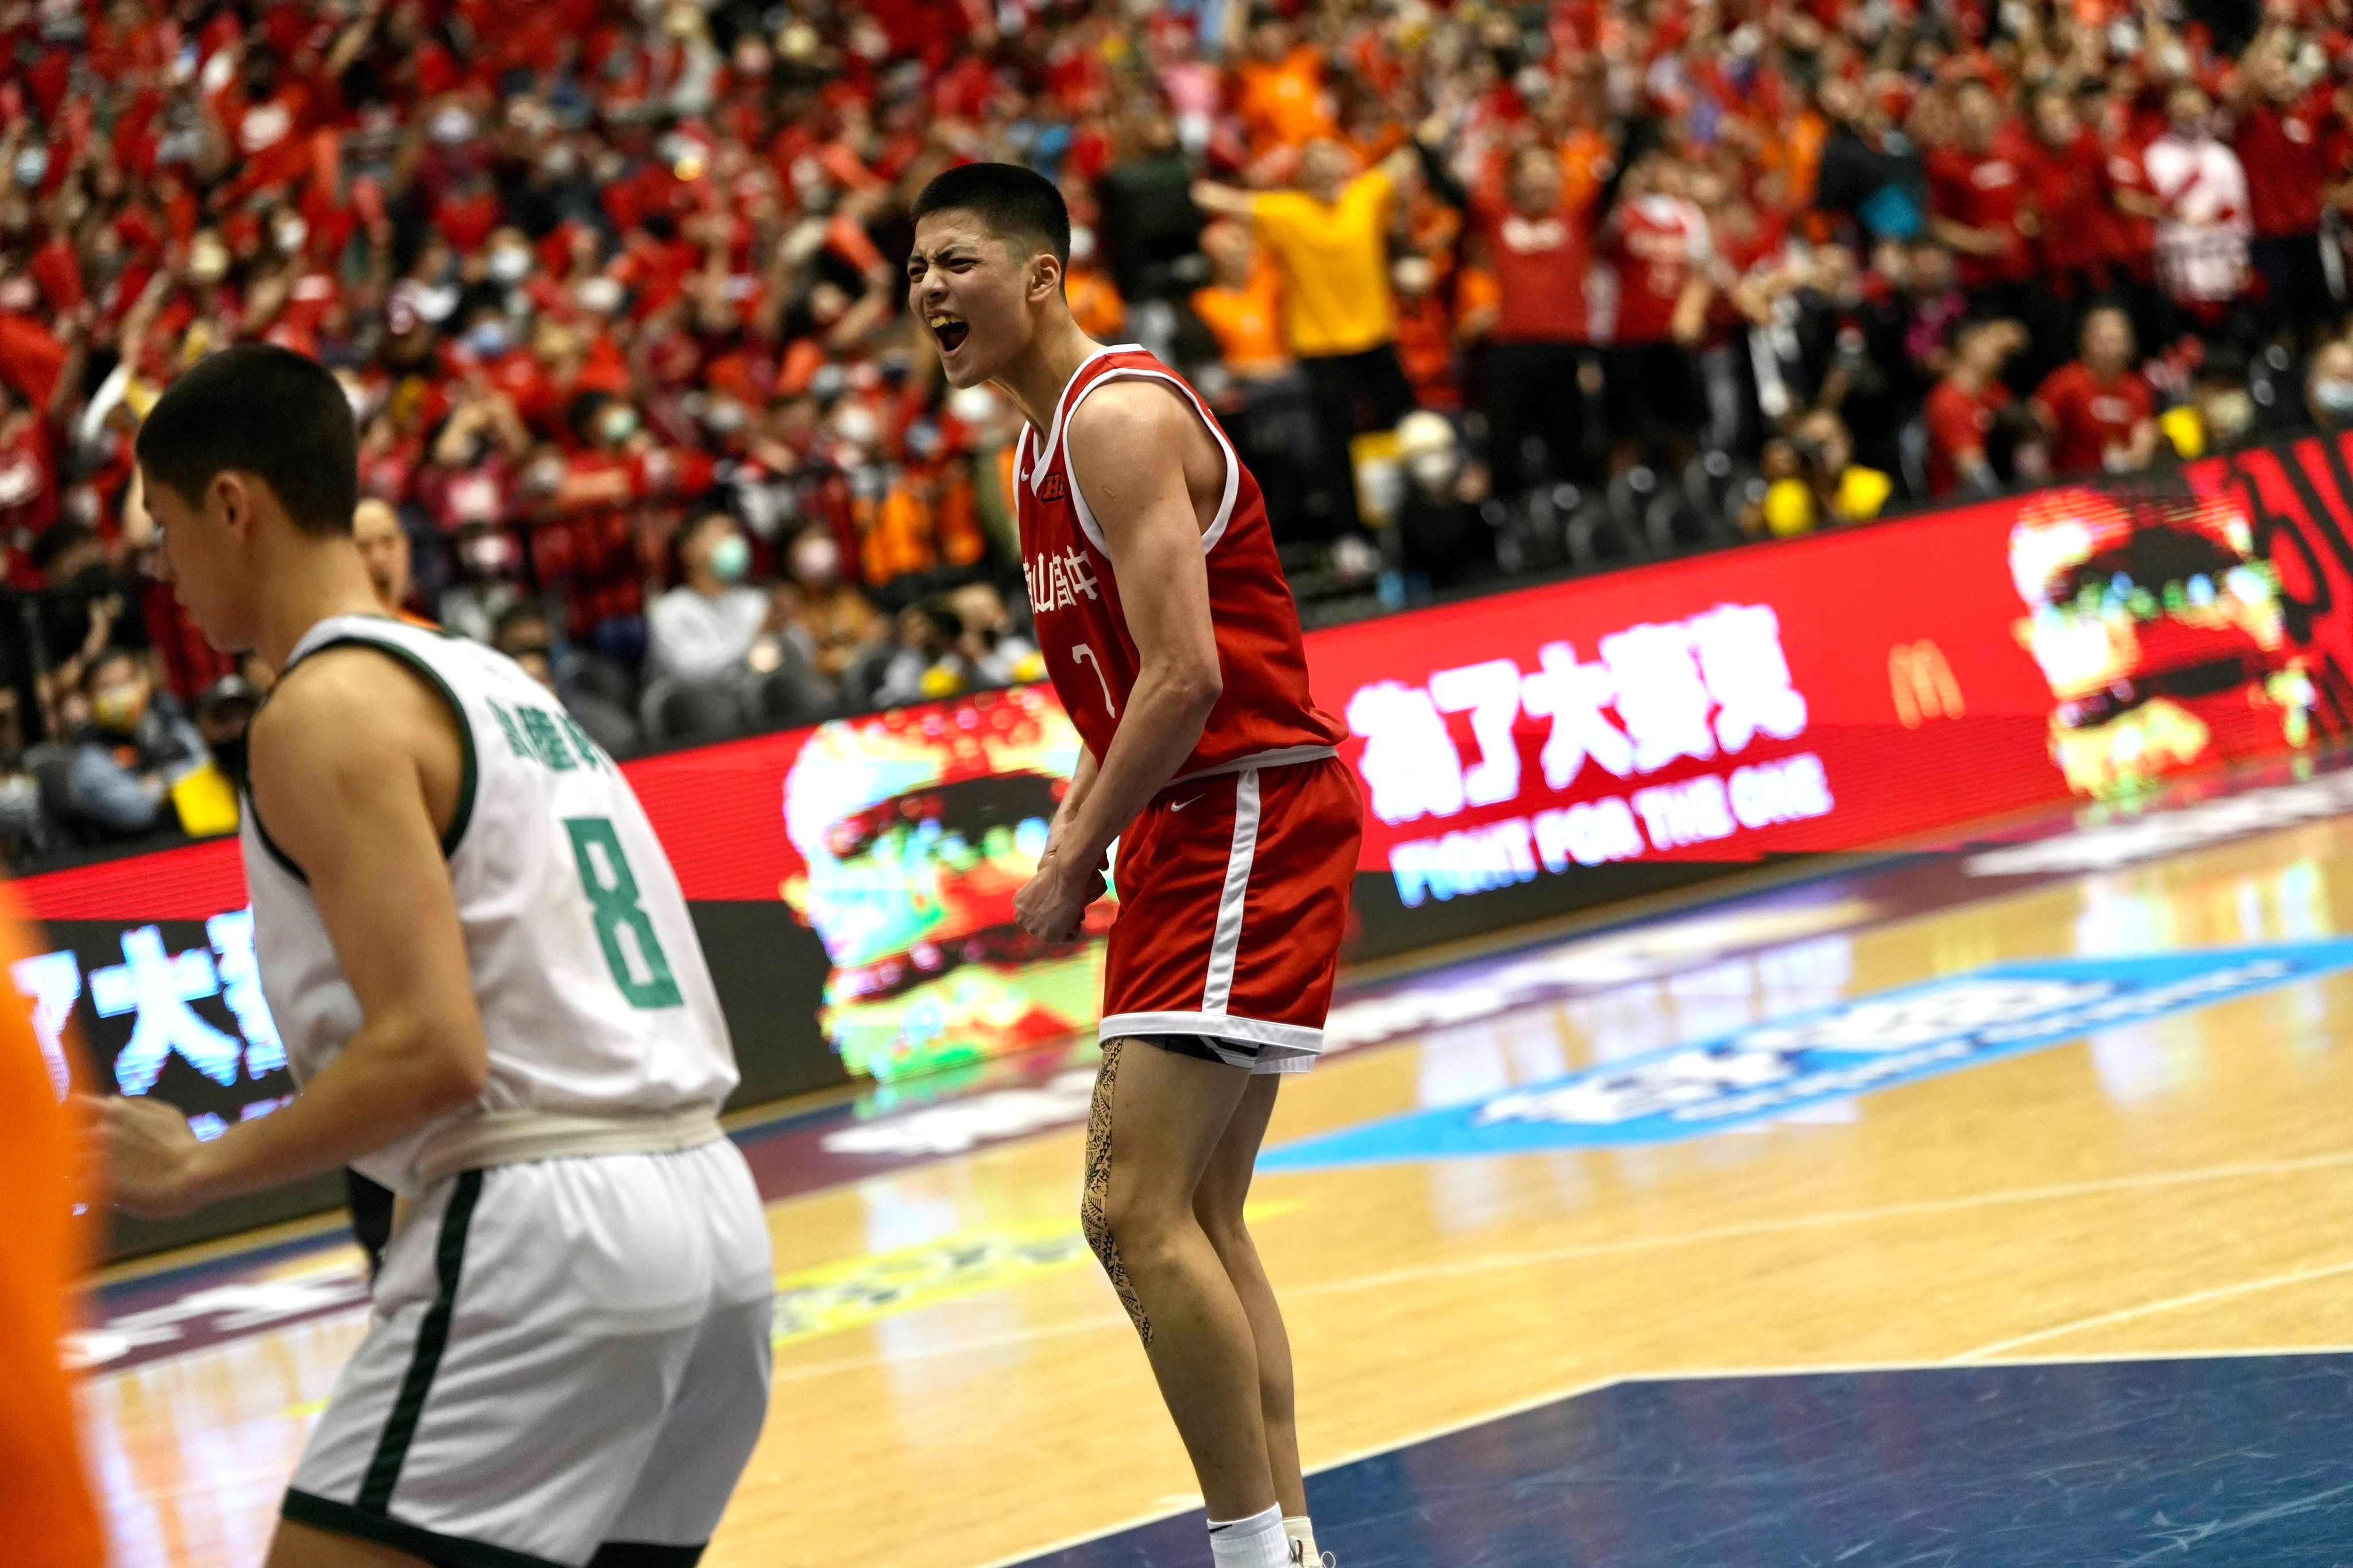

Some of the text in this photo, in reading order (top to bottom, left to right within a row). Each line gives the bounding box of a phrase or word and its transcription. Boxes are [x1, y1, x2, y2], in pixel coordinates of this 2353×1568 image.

[1072, 643, 1115, 719] 7
[1532, 796, 1645, 874] FOR
[1632, 775, 1737, 850] THE
[1729, 752, 1834, 828] ONE
[564, 817, 683, 1009] 8
